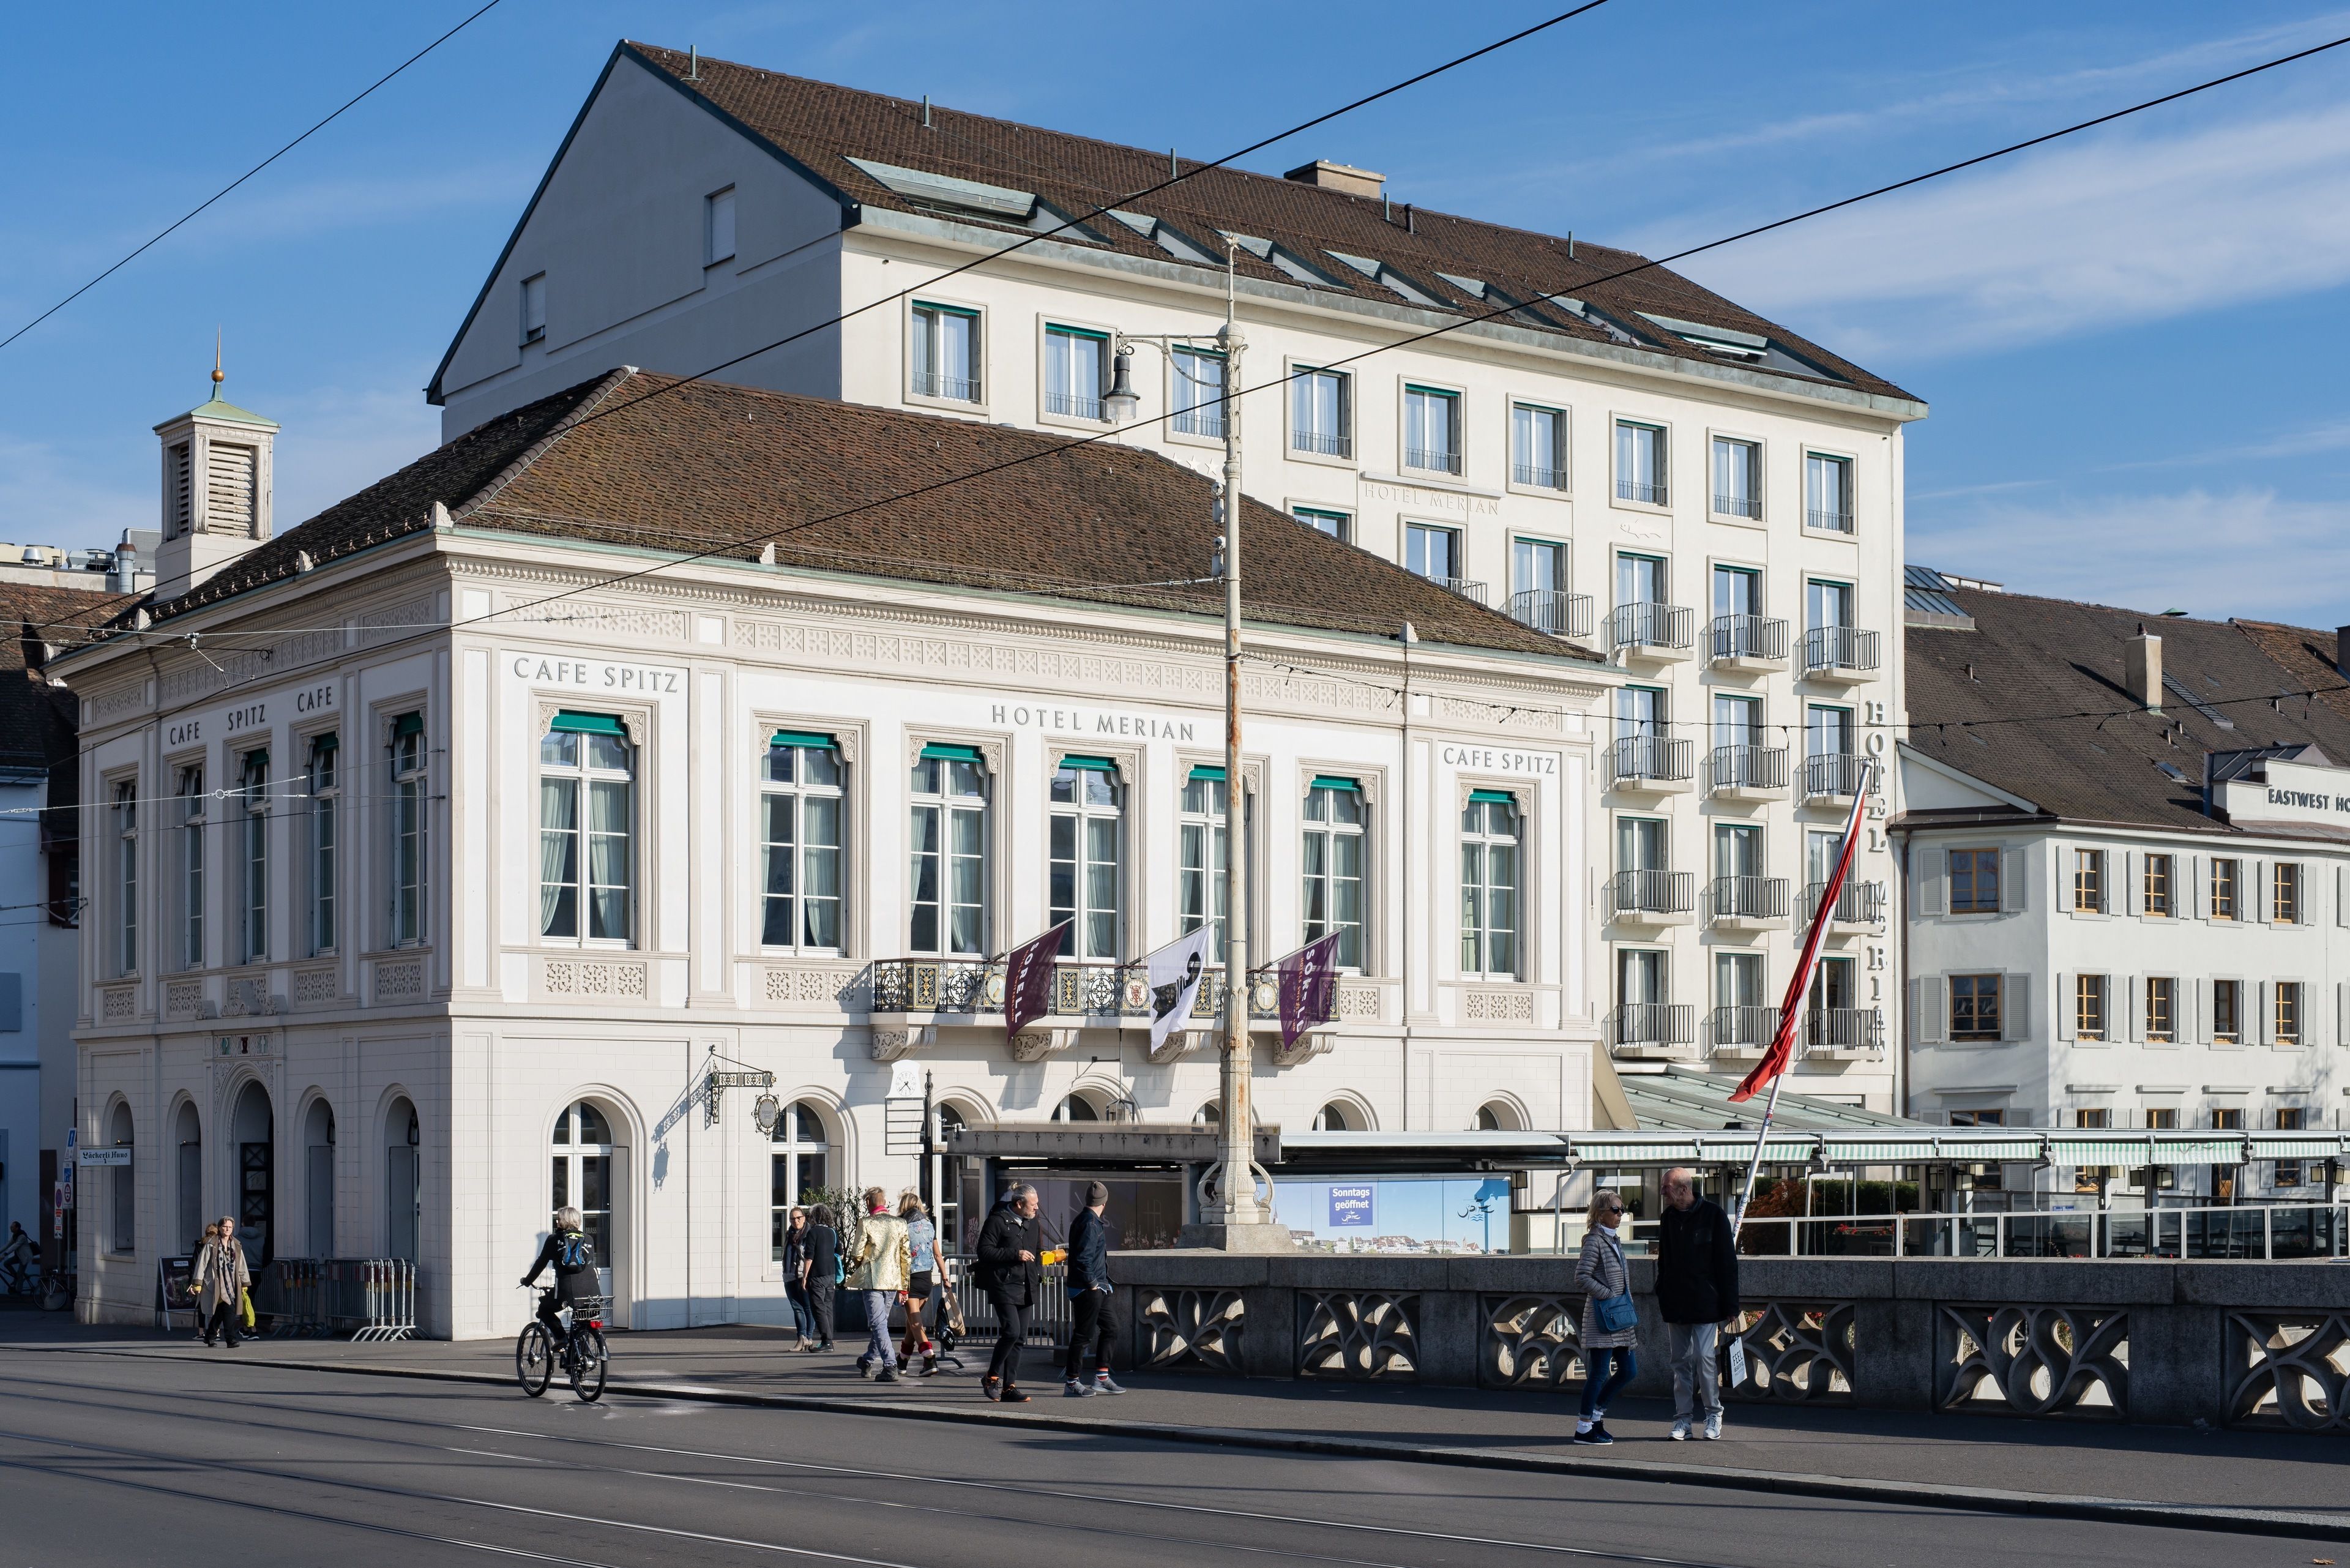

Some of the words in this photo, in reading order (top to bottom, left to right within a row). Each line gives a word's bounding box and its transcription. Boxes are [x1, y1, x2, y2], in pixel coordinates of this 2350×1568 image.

[1365, 483, 1420, 504] HOTEL
[1430, 492, 1498, 515] MERIAN
[514, 657, 586, 684] CAFE
[605, 666, 678, 693] SPITZ
[170, 722, 200, 745] CAFE
[228, 704, 265, 731] SPITZ
[297, 686, 332, 712] CAFE
[993, 705, 1081, 731] HOTEL
[1097, 714, 1193, 741] MERIAN
[1444, 747, 1492, 767] CAFE
[1502, 753, 1554, 774] SPITZ
[2268, 788, 2329, 810] EASTWEST
[1015, 942, 1040, 1023] SORELL
[1332, 1188, 1370, 1198] Sonntags
[1335, 1200, 1370, 1211] geöffnet
[1733, 1350, 1743, 1367] FEEL
